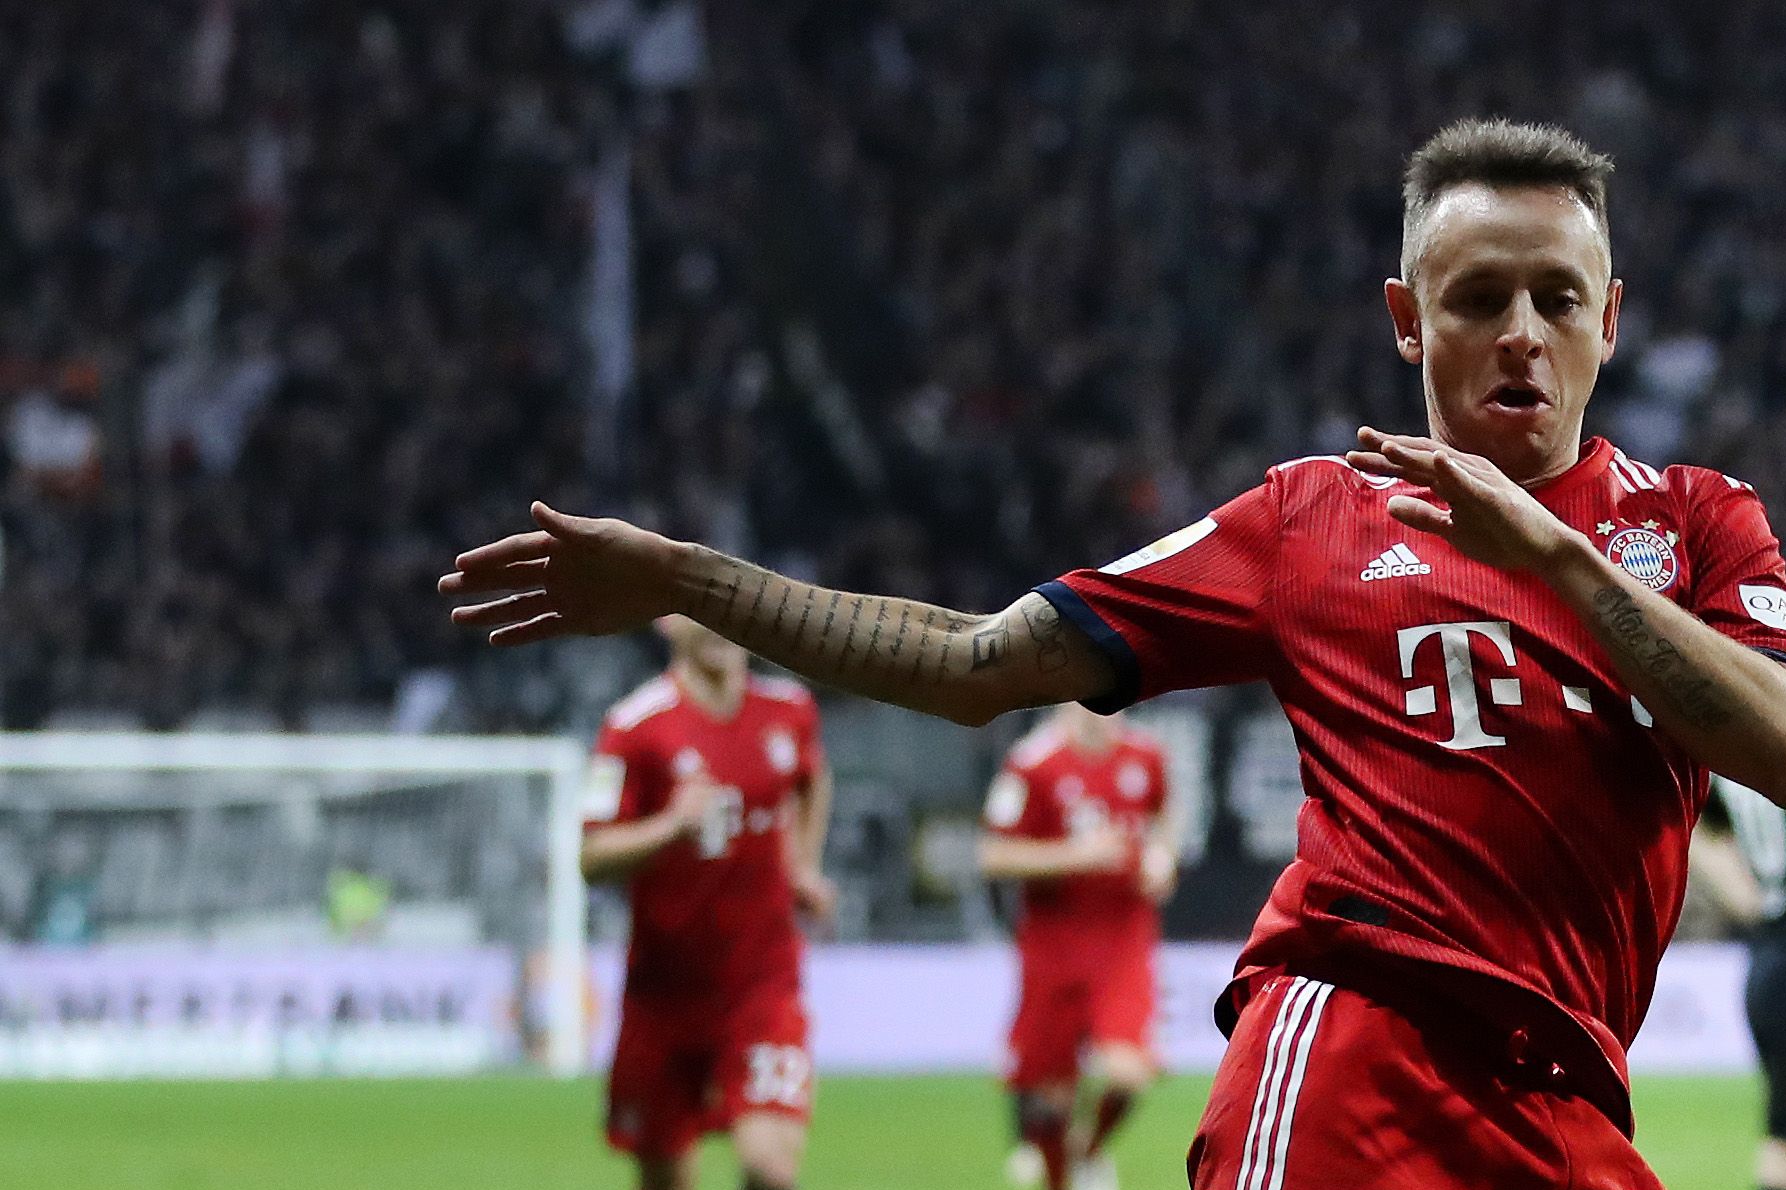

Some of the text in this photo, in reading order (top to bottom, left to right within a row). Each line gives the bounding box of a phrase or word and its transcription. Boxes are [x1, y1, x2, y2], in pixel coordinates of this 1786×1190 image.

[1626, 532, 1671, 560] BAYERN
[1360, 563, 1432, 582] adidas
[1397, 621, 1522, 750] T
